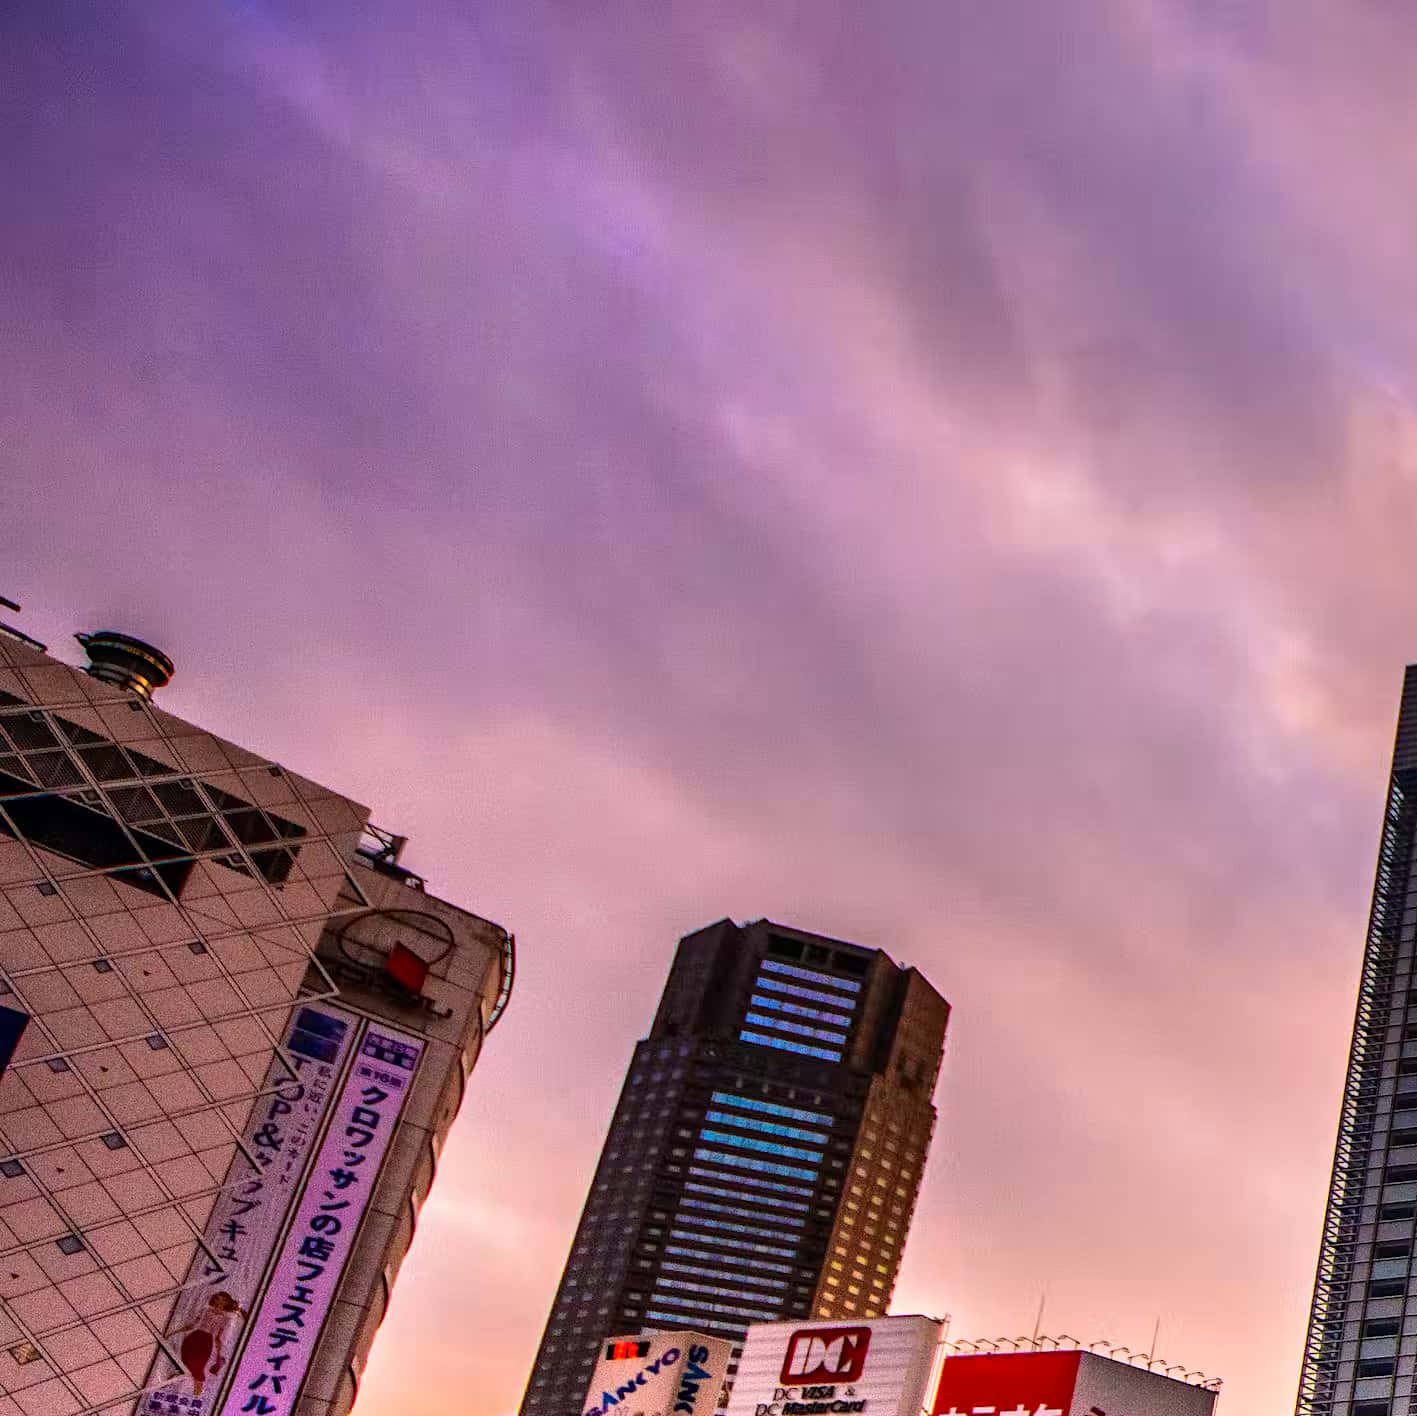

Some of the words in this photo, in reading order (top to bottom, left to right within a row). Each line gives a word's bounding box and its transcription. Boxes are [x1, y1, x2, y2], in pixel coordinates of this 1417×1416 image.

[241, 1086, 389, 1416] クロワッサンの店フェスティバル
[789, 1334, 860, 1376] DC
[773, 1386, 798, 1402] DC
[800, 1384, 836, 1400] VISA
